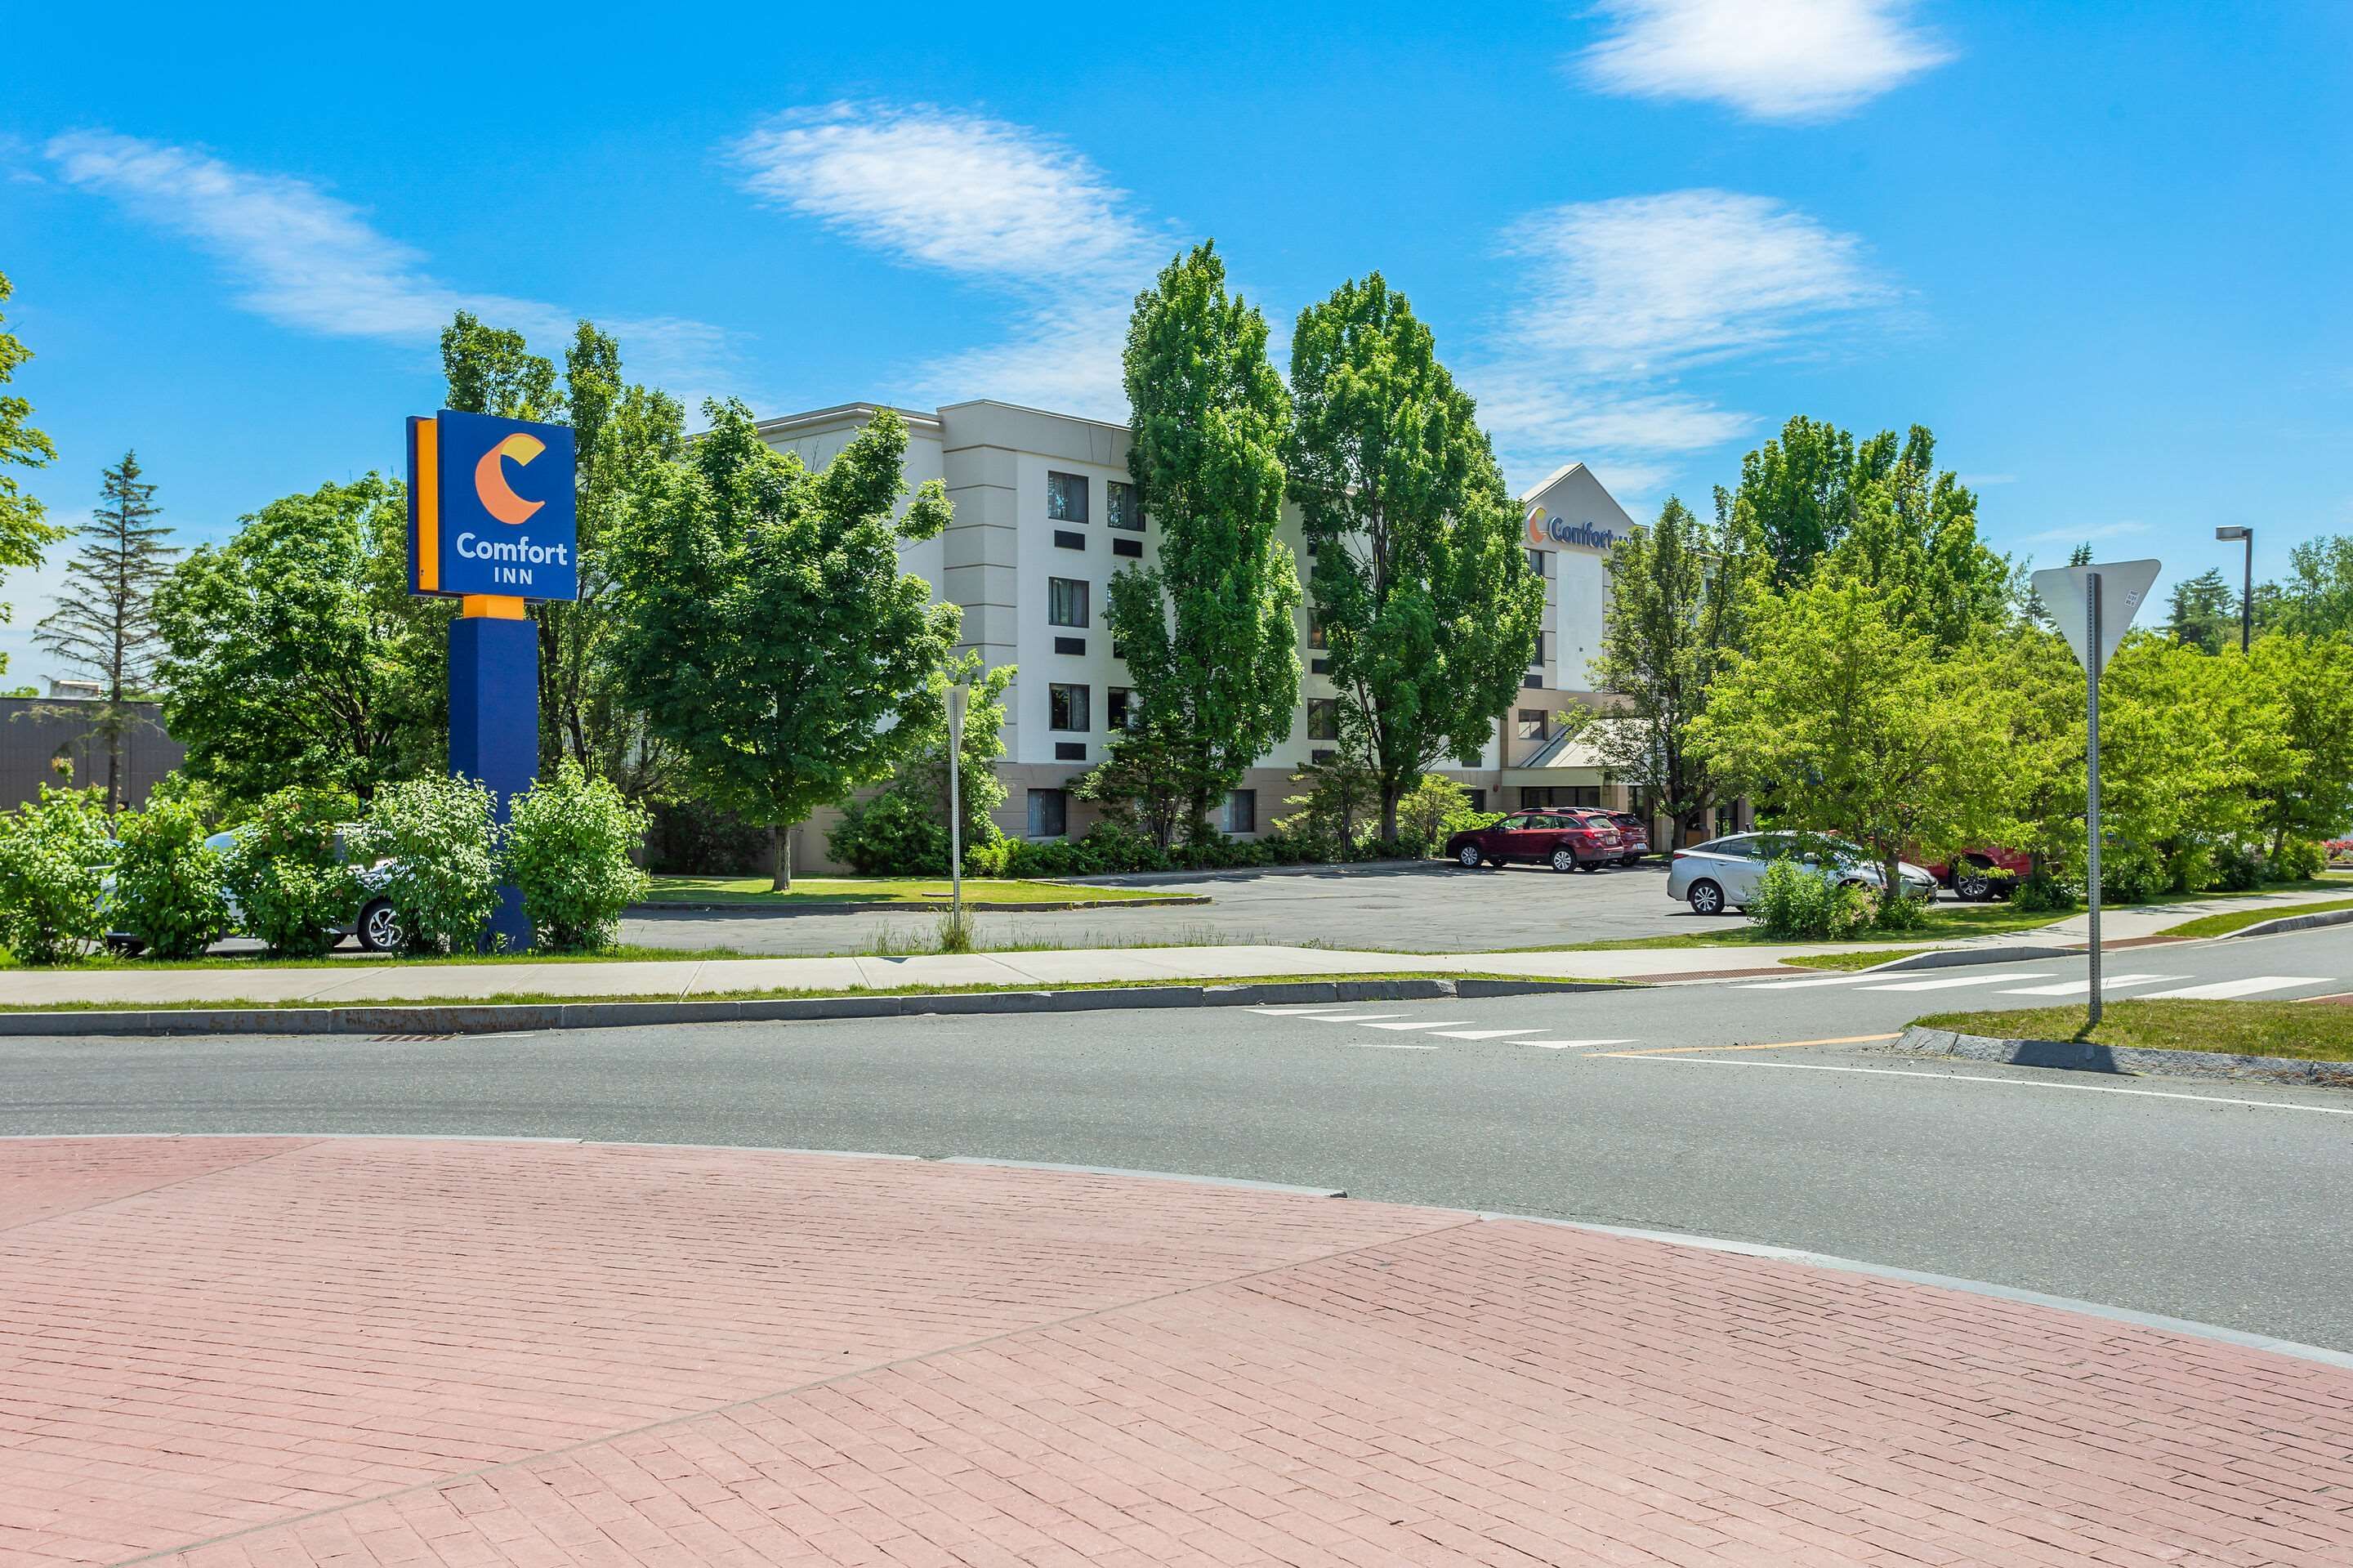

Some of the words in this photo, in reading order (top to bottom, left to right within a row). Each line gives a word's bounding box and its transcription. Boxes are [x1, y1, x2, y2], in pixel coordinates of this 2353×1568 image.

[457, 532, 568, 565] Comfort
[1548, 516, 1614, 550] Comfort
[494, 567, 533, 585] INN
